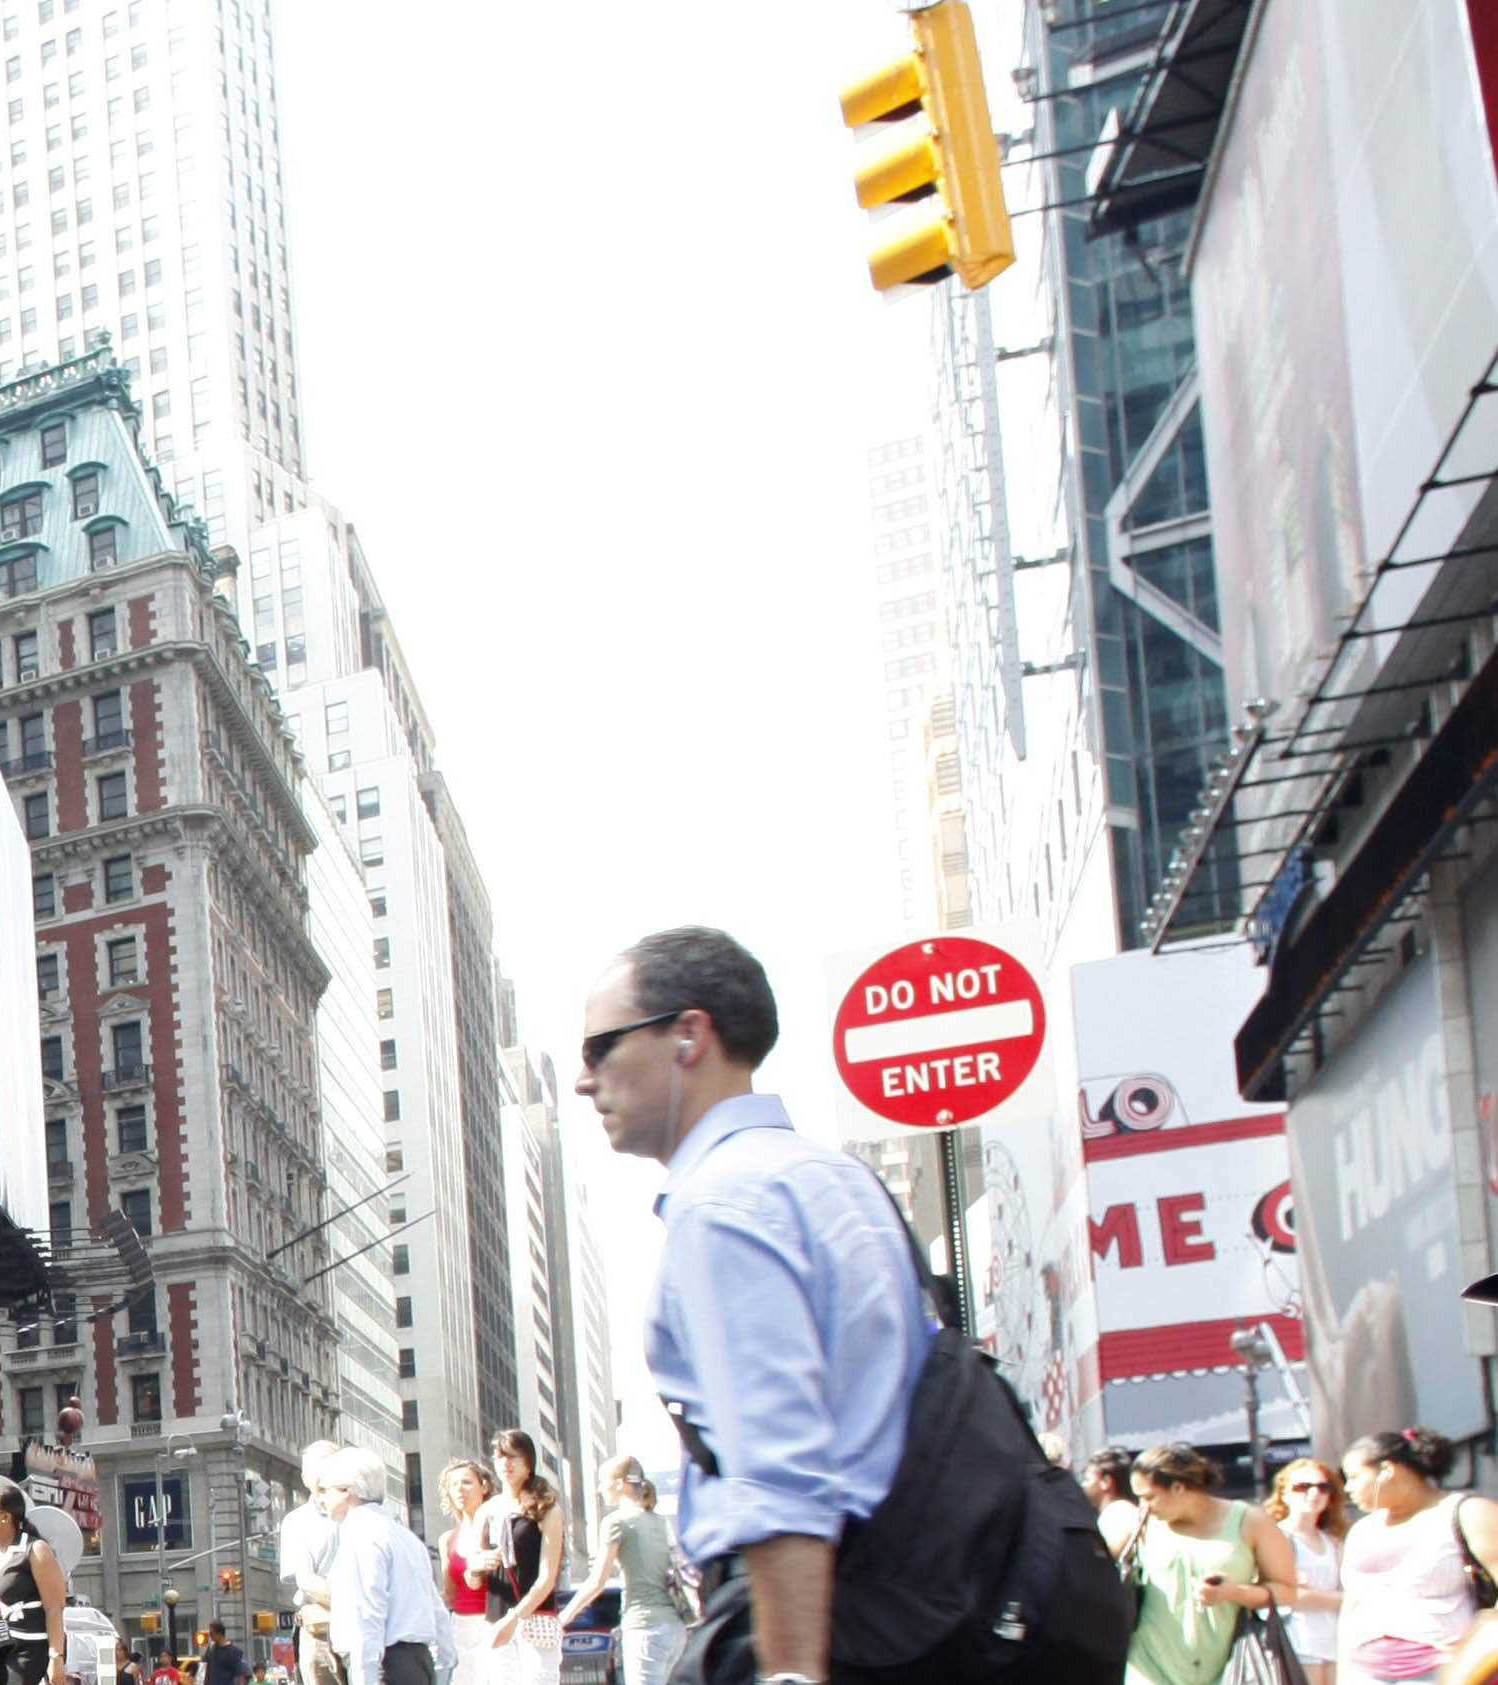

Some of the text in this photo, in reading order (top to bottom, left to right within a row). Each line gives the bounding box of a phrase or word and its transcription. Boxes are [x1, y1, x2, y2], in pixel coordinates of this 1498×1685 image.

[864, 963, 1002, 1016] DO NOT
[881, 1051, 1002, 1098] ENTER
[133, 1493, 173, 1529] GAP
